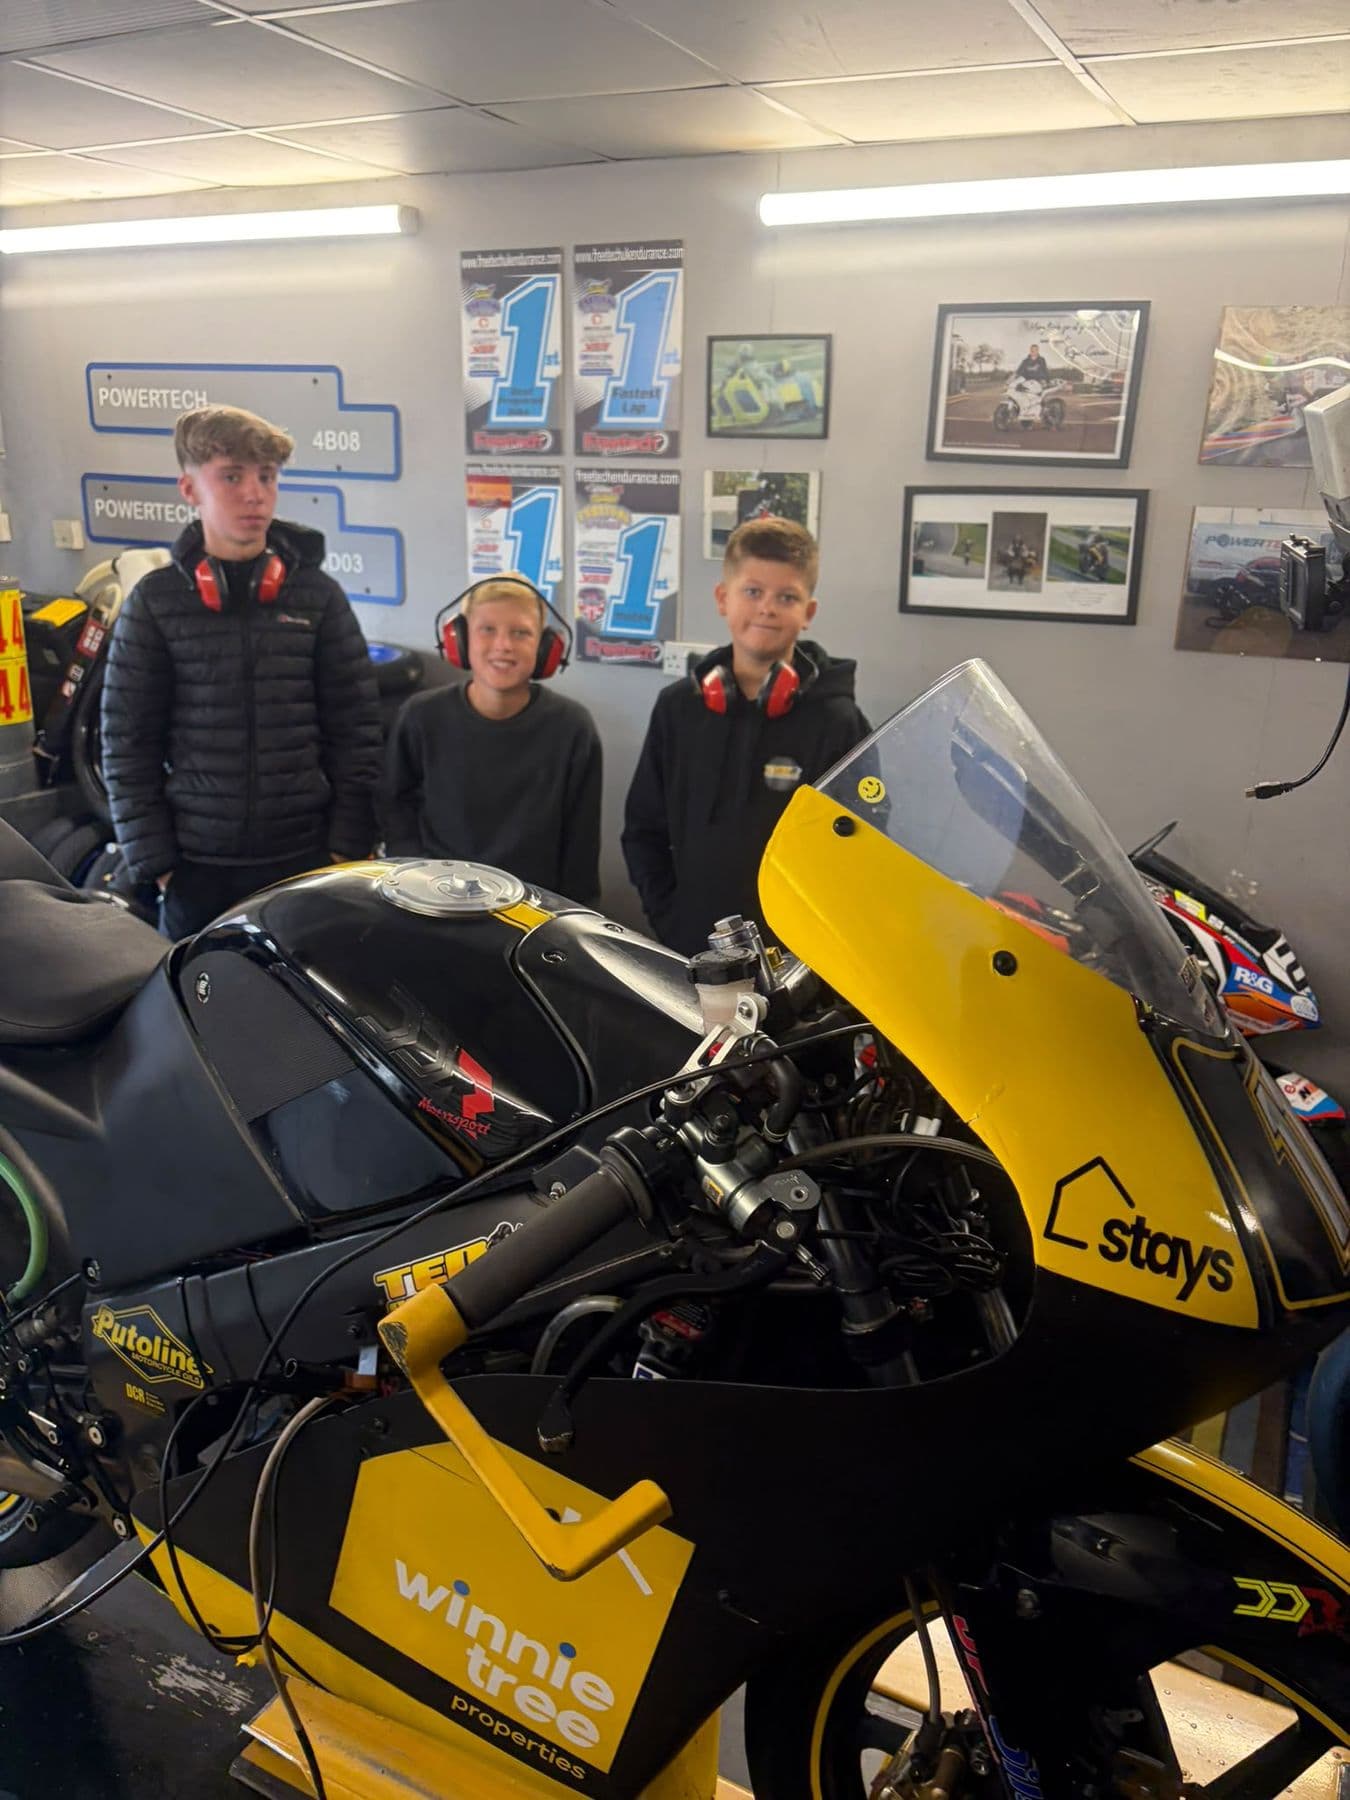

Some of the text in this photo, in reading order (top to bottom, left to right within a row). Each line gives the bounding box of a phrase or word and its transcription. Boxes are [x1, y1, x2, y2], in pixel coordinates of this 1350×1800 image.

[98, 387, 208, 409] POWERTECH
[622, 401, 645, 414] Lap
[312, 429, 361, 452] 4B08
[94, 498, 200, 523] POWERTECH
[1234, 966, 1274, 994] R&G
[1098, 1215, 1235, 1302] stays
[93, 1308, 201, 1376] Putoline
[131, 1352, 181, 1377] MOTORCYCLE
[395, 1559, 615, 1712] winnie
[465, 1642, 600, 1748] tree
[451, 1694, 586, 1780] properties
